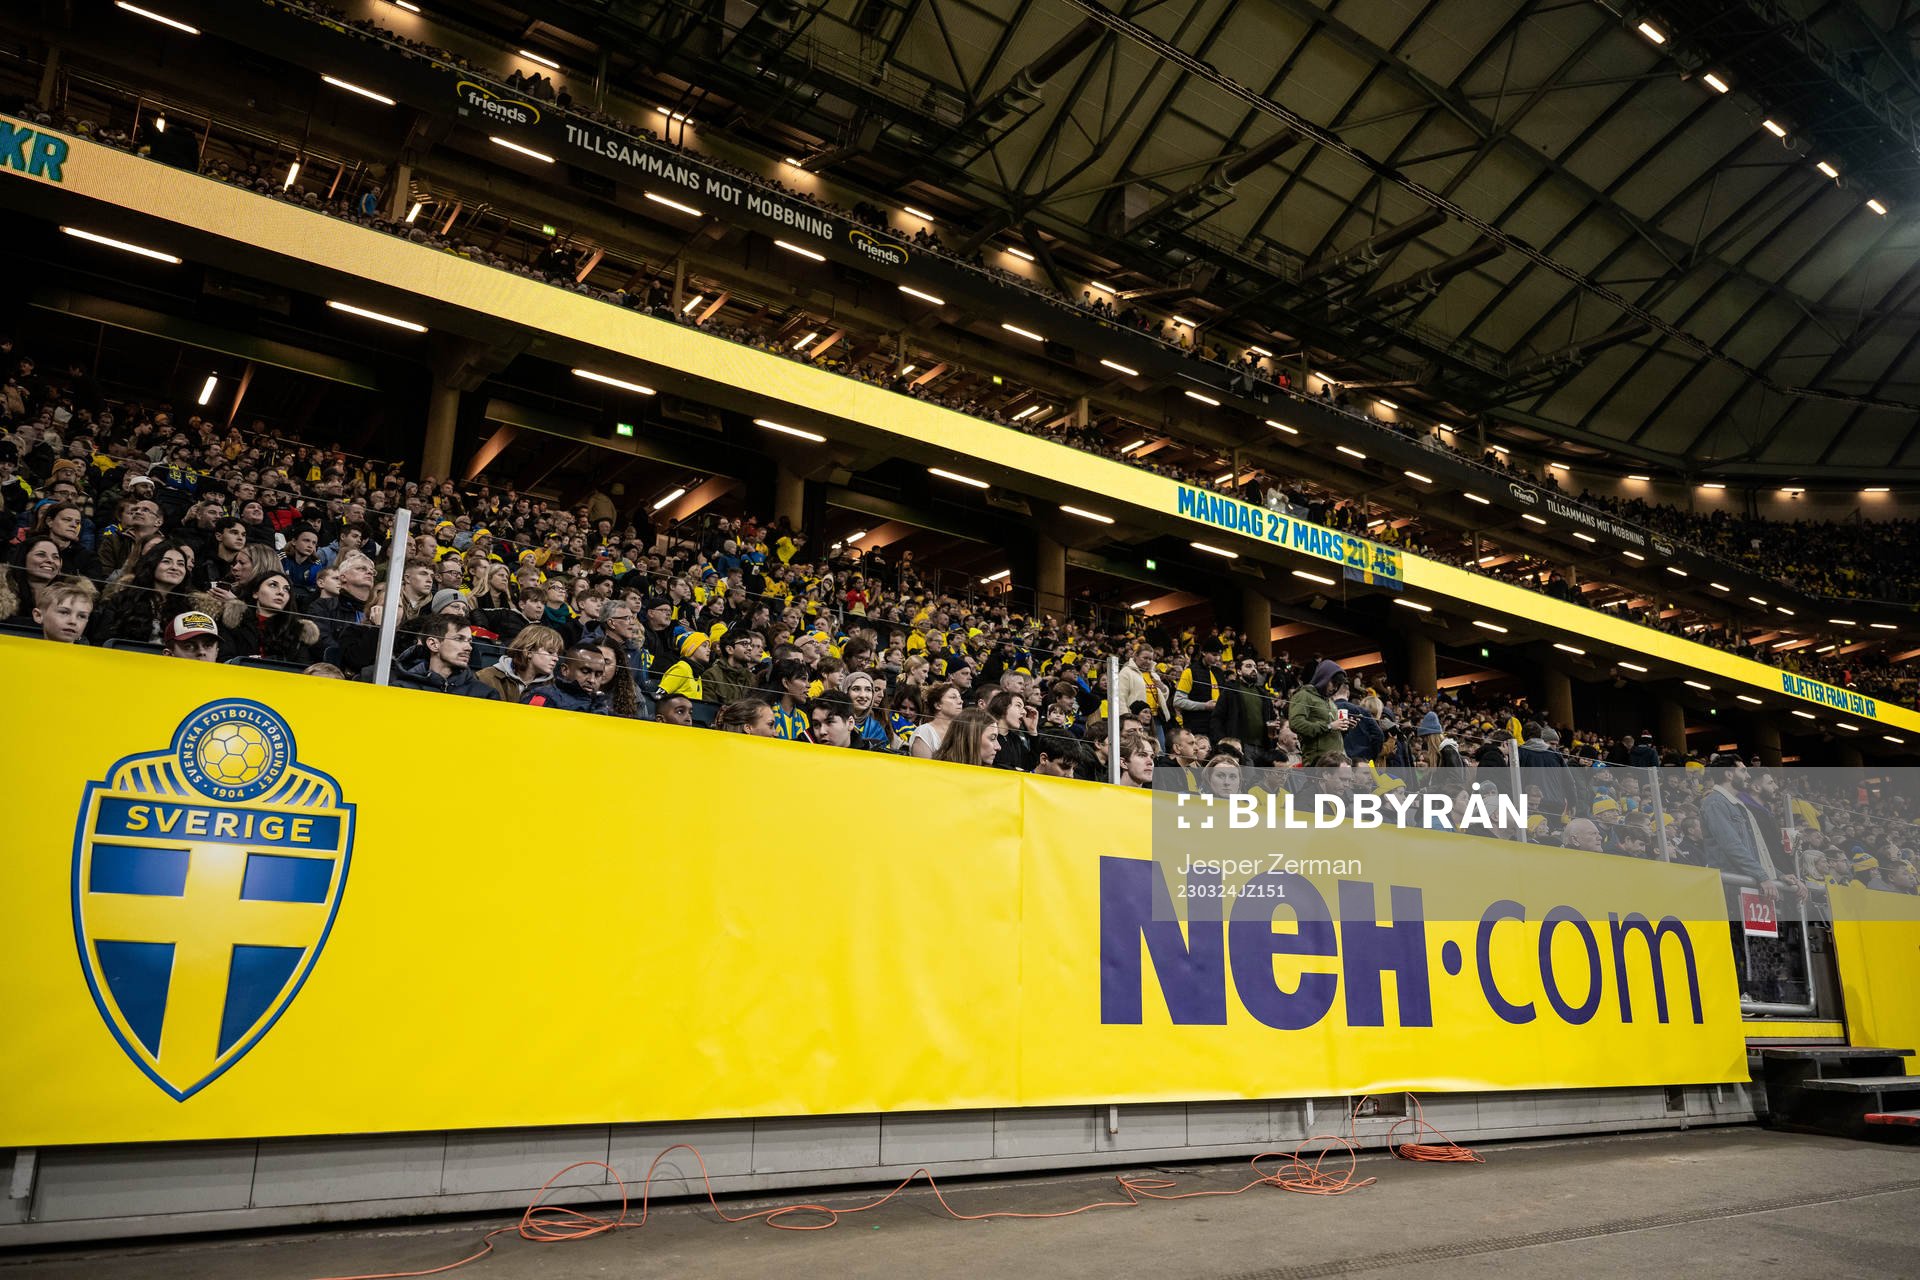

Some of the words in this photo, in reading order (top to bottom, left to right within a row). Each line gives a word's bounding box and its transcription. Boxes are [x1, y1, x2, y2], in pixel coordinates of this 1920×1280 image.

[468, 92, 527, 123] friends
[0, 120, 69, 182] KR
[566, 124, 700, 190] TILLSAMMANS
[706, 178, 742, 205] MOT
[747, 193, 833, 240] MOBBNING
[857, 239, 900, 264] friends
[1178, 486, 1263, 537] MÅNDAG
[1267, 514, 1289, 544] 27
[1293, 522, 1344, 561] MARS
[1546, 499, 1596, 528] TILLSAMMANS
[1596, 518, 1610, 532] MOT
[1611, 524, 1645, 546] MOBBNING
[1782, 673, 1825, 703] BILJETTER
[1849, 693, 1864, 715] 150
[1865, 698, 1877, 718] KR
[183, 726, 203, 783] SVENSKA
[202, 709, 284, 790] FOTBOLLFÖRBUNDET
[212, 787, 245, 798] 1904
[126, 805, 314, 843] SVERIGE
[1749, 902, 1771, 923] 122
